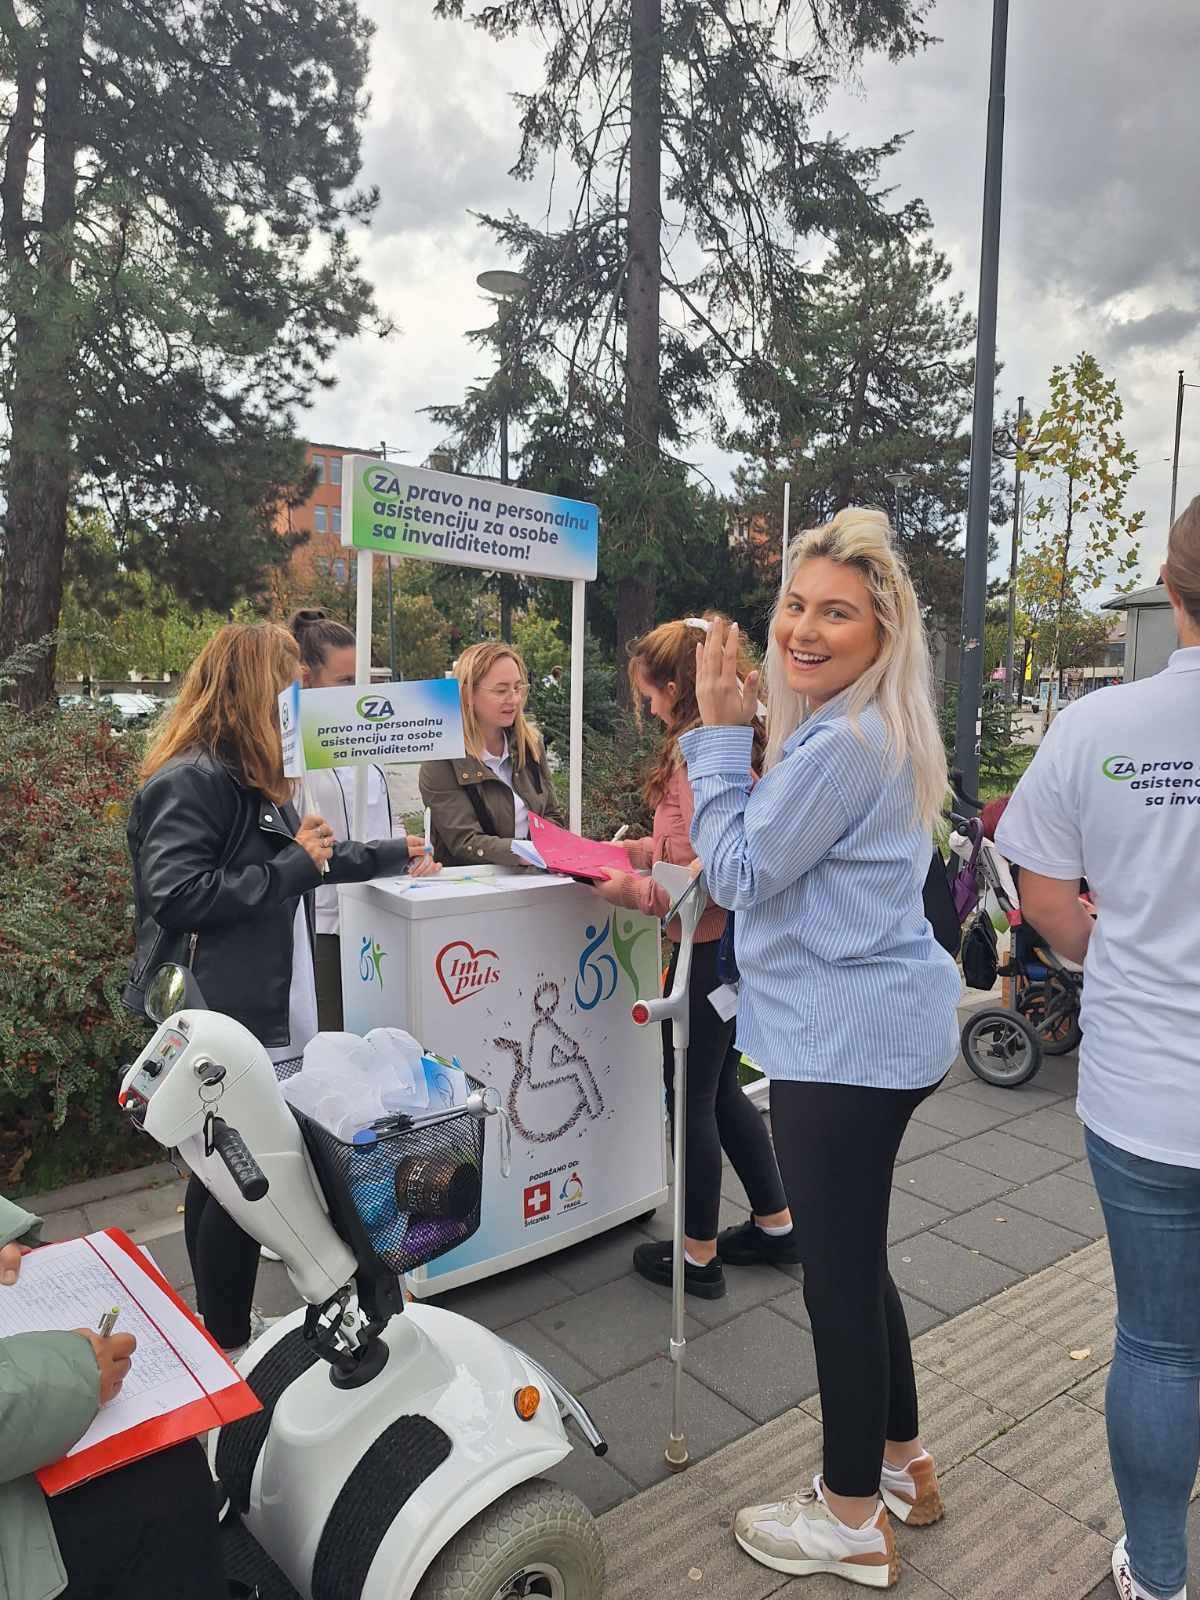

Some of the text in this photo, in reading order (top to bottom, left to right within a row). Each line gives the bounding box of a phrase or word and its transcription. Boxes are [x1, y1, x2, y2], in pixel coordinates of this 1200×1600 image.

[372, 474, 590, 531] ZA pravo na personalnu
[373, 500, 559, 545] asistenciju za osobe
[372, 522, 531, 560] sa invaliditetom!
[363, 700, 395, 718] ZA
[317, 717, 443, 737] pravo na personalnu
[321, 729, 443, 748] asistenciju za osobe
[333, 742, 434, 759] sa invaliditetom!
[1113, 760, 1194, 775] ZA pravo
[1145, 796, 1164, 806] sa
[450, 958, 479, 977] Im
[455, 966, 500, 995] puls
